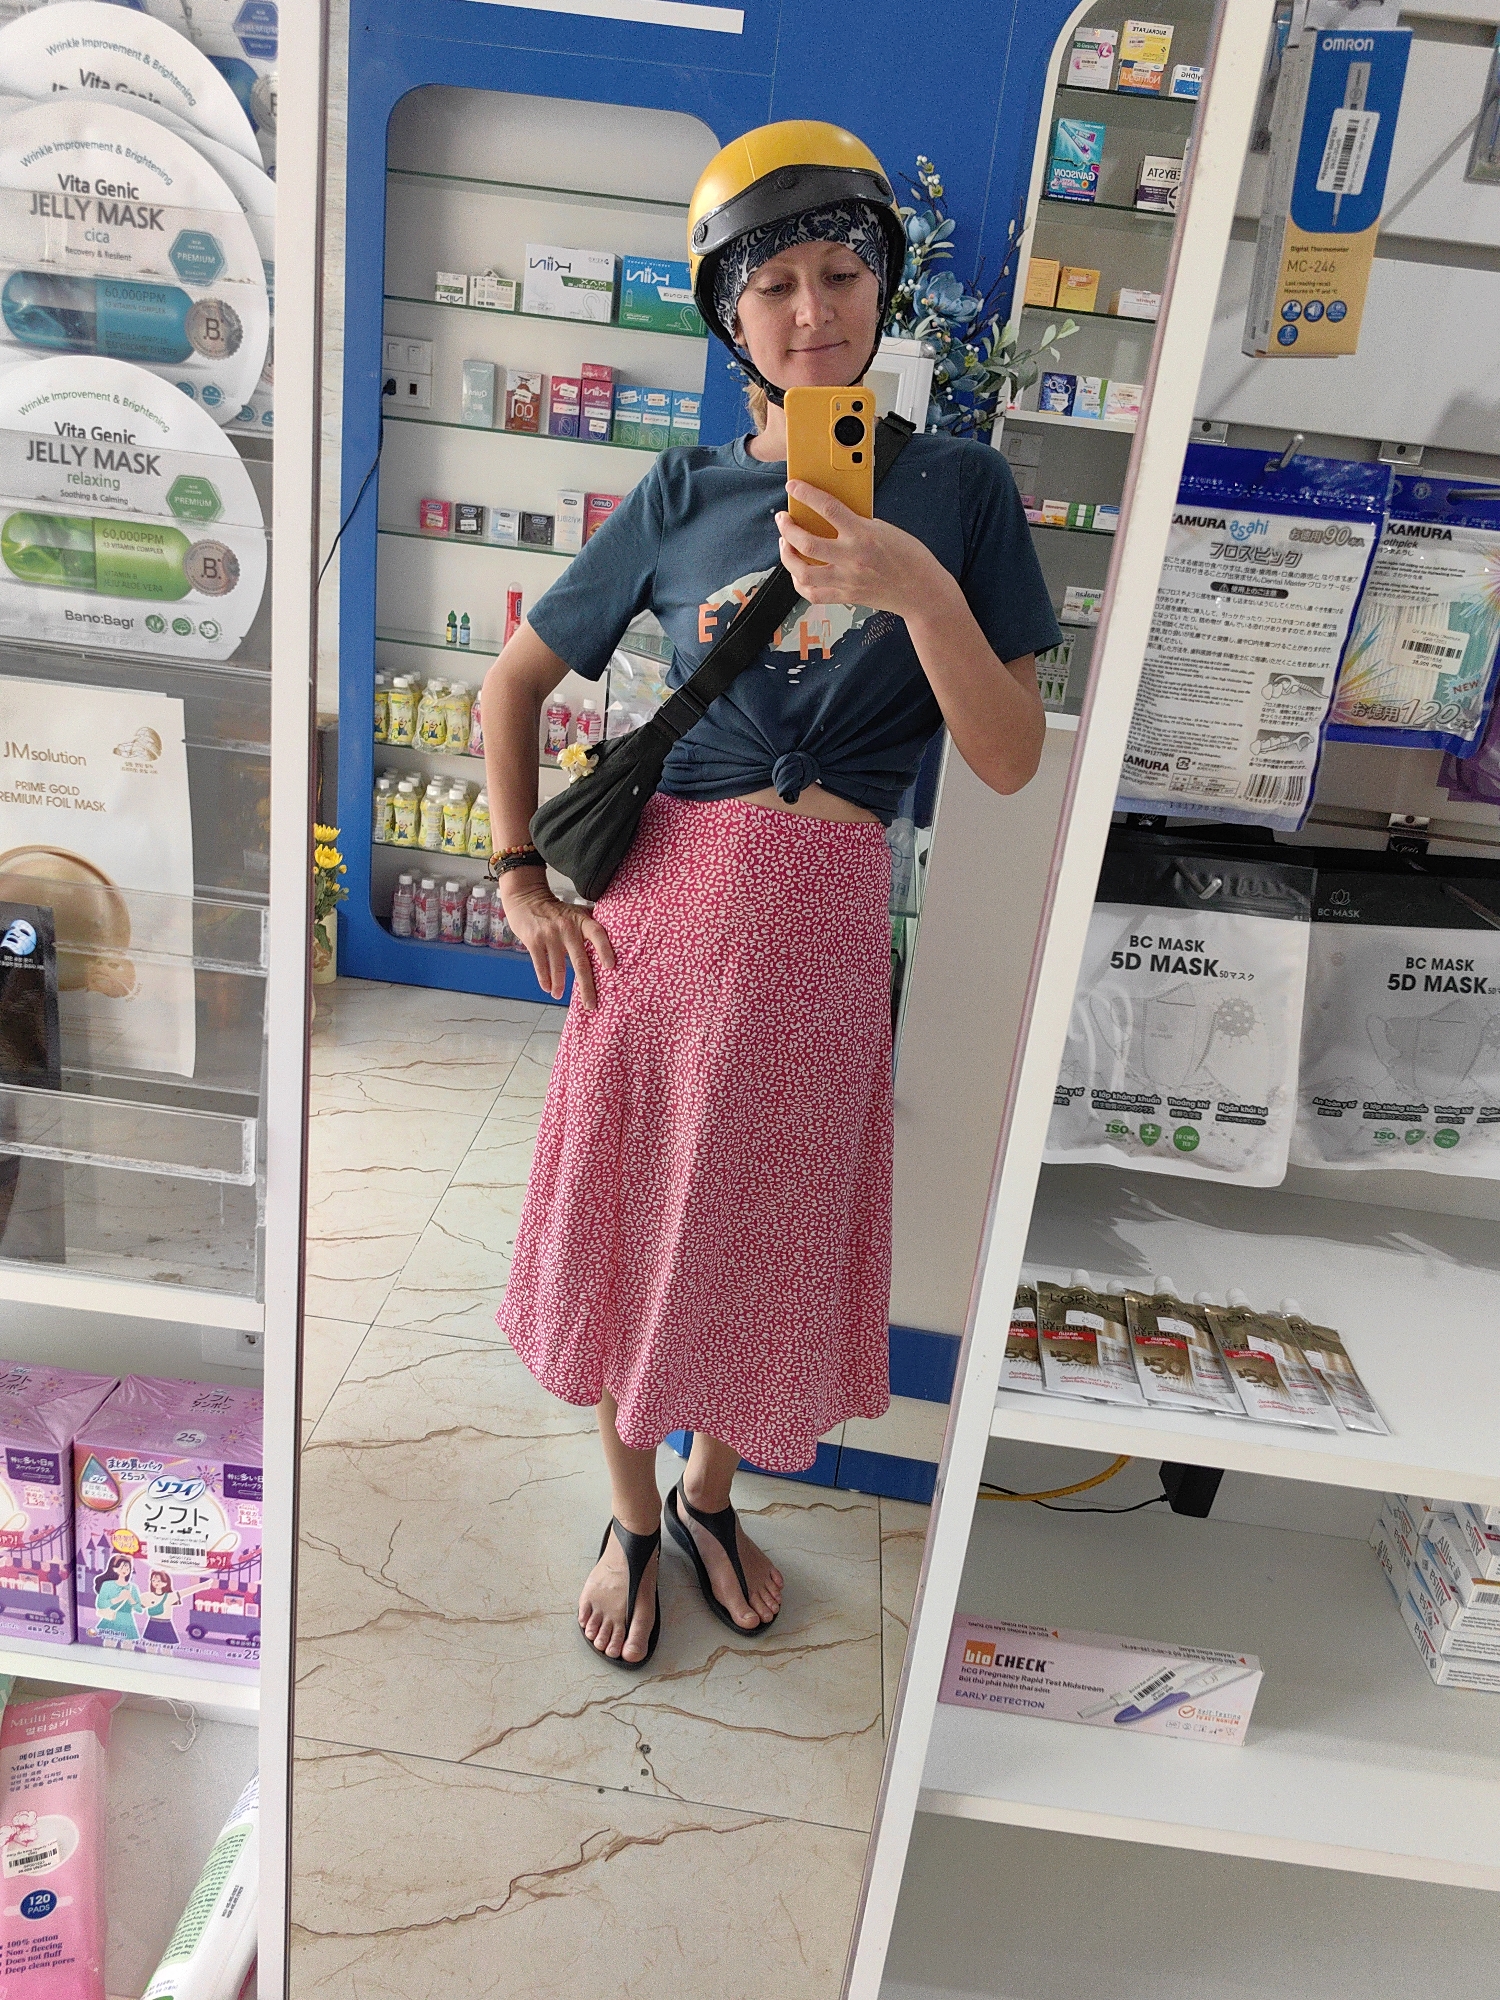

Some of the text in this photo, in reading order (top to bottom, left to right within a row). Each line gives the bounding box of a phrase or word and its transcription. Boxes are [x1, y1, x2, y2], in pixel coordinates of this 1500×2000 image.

[1322, 38, 1374, 52] OMRON
[47, 38, 196, 107] Wrinkle Improvement & Brightening
[21, 140, 173, 186] Wrinkle Improvement & Brightening
[58, 174, 139, 200] Vita Genic
[30, 193, 165, 231] JELLY MASK
[84, 229, 110, 243] cica
[177, 253, 215, 265] PREMIUM
[1287, 260, 1336, 273] MC-246
[18, 390, 170, 433] Wrinkle Improvement & Brightening
[54, 421, 136, 446] Vita Genic
[26, 441, 162, 477] JELLY MASK
[67, 471, 121, 490] relaxing
[60, 489, 91, 501] Soothing
[100, 494, 129, 505] Calming
[174, 496, 211, 508] PREMIUM
[102, 528, 164, 545] 60,000PPM
[1172, 515, 1269, 541] AMURA asahi
[1386, 522, 1453, 541] KAMURA
[1453, 679, 1480, 694] NEW
[4, 741, 87, 766] JMsolution
[15, 780, 80, 796] PRIME GOLD
[0, 791, 106, 812] REMIUM FOIL MASK
[1317, 907, 1361, 919] BC MASK
[1129, 934, 1205, 953] BC MASK
[1110, 951, 1142, 971] 5D
[1150, 955, 1219, 978] MASK
[1405, 956, 1475, 972] BC MASK
[1387, 973, 1488, 994] 5D MASK
[1105, 1123, 1129, 1134] ISO
[1373, 1131, 1396, 1140] ISO
[145, 1503, 209, 1527] ソフト
[1429, 1568, 1448, 1606] Allisa
[961, 1666, 1105, 1693] hCG Pregnancy Rapid Test Midstream
[955, 1689, 1045, 1709] EARLY DETECTION
[10, 1704, 87, 1728] Multi Silky
[11, 1754, 79, 1772] Make Up Cotton
[28, 1904, 50, 1914] PADS
[29, 1894, 51, 1906] 120
[7, 1934, 58, 1948] 100% cotton
[5, 1949, 62, 1966] Does not fluff
[6, 1948, 23, 1957] Non
[5, 1957, 75, 1975] Deep clean pores
